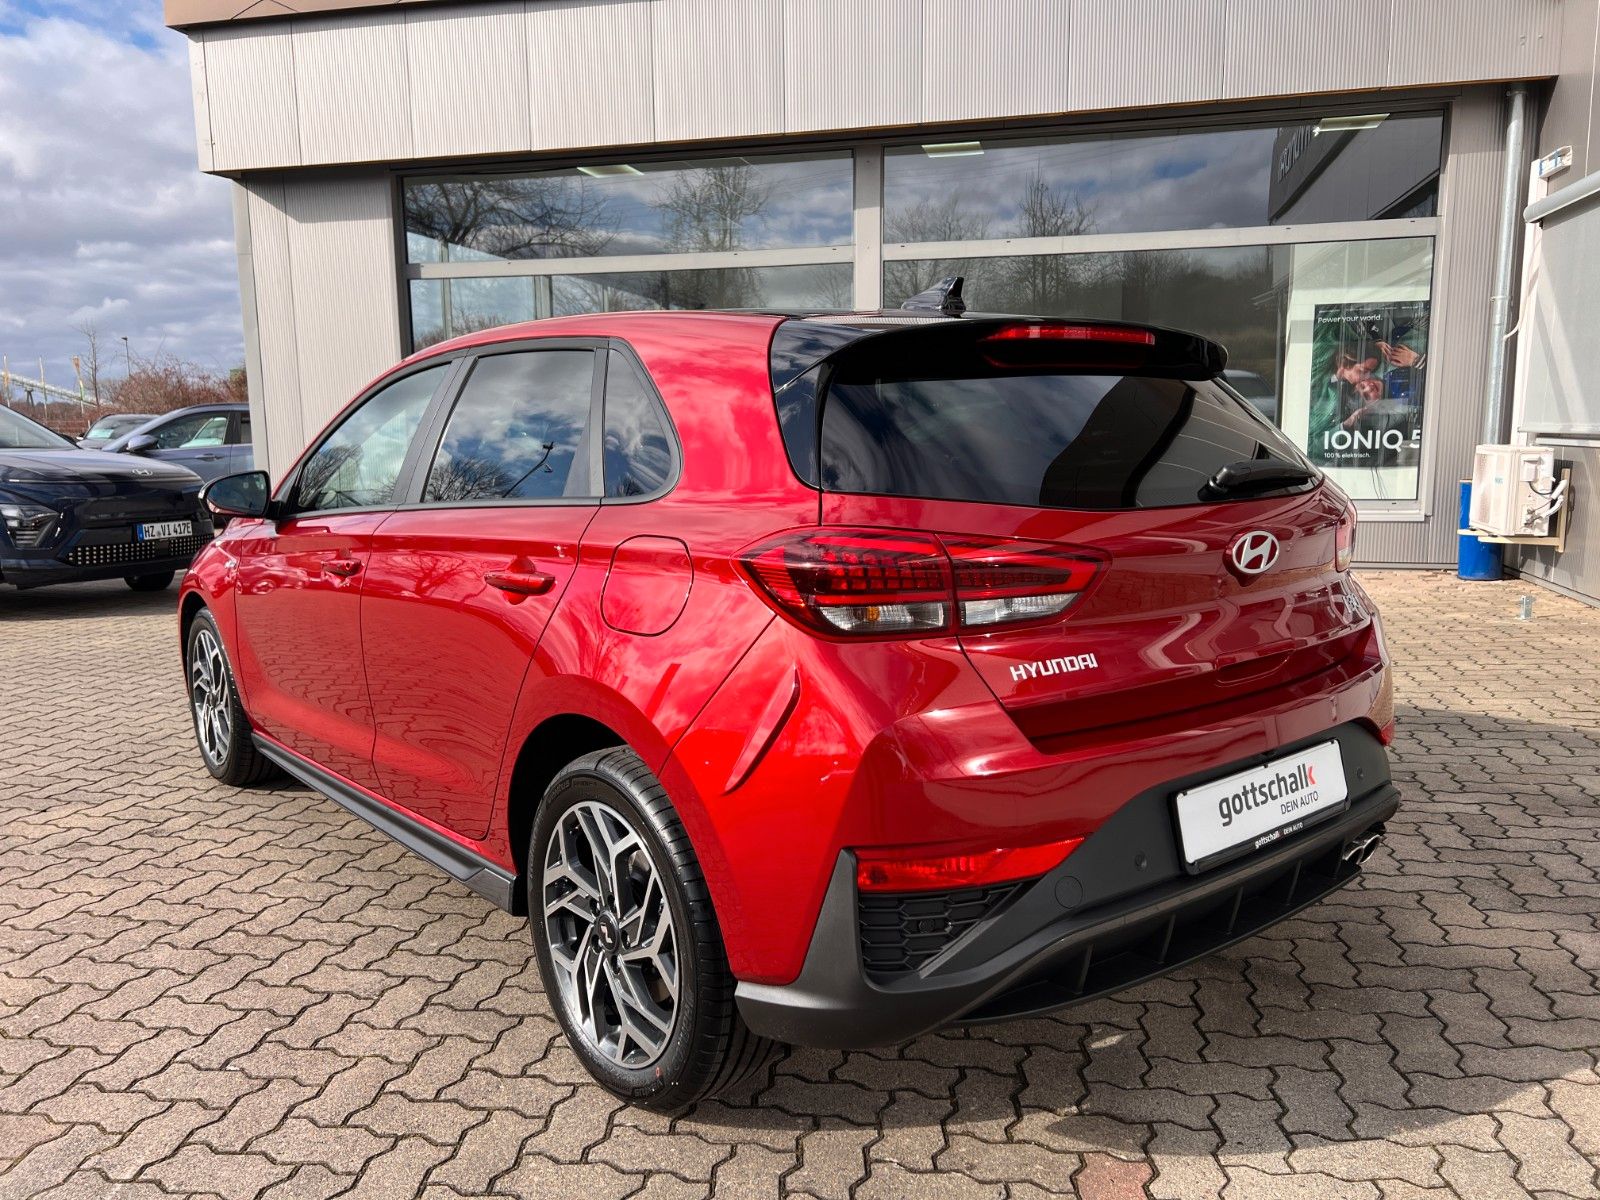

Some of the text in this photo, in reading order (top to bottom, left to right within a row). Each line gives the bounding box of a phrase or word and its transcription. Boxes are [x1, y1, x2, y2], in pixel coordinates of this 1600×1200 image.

[1317, 313, 1383, 324] Power your world.
[1324, 429, 1421, 453] IONIQ 5
[144, 522, 192, 538] HZ VI 417E
[1009, 652, 1099, 681] HYUNDAI
[1218, 763, 1316, 827] gottschalk
[1280, 790, 1319, 815] DEIN AUTO
[1283, 825, 1293, 835] DEIN
